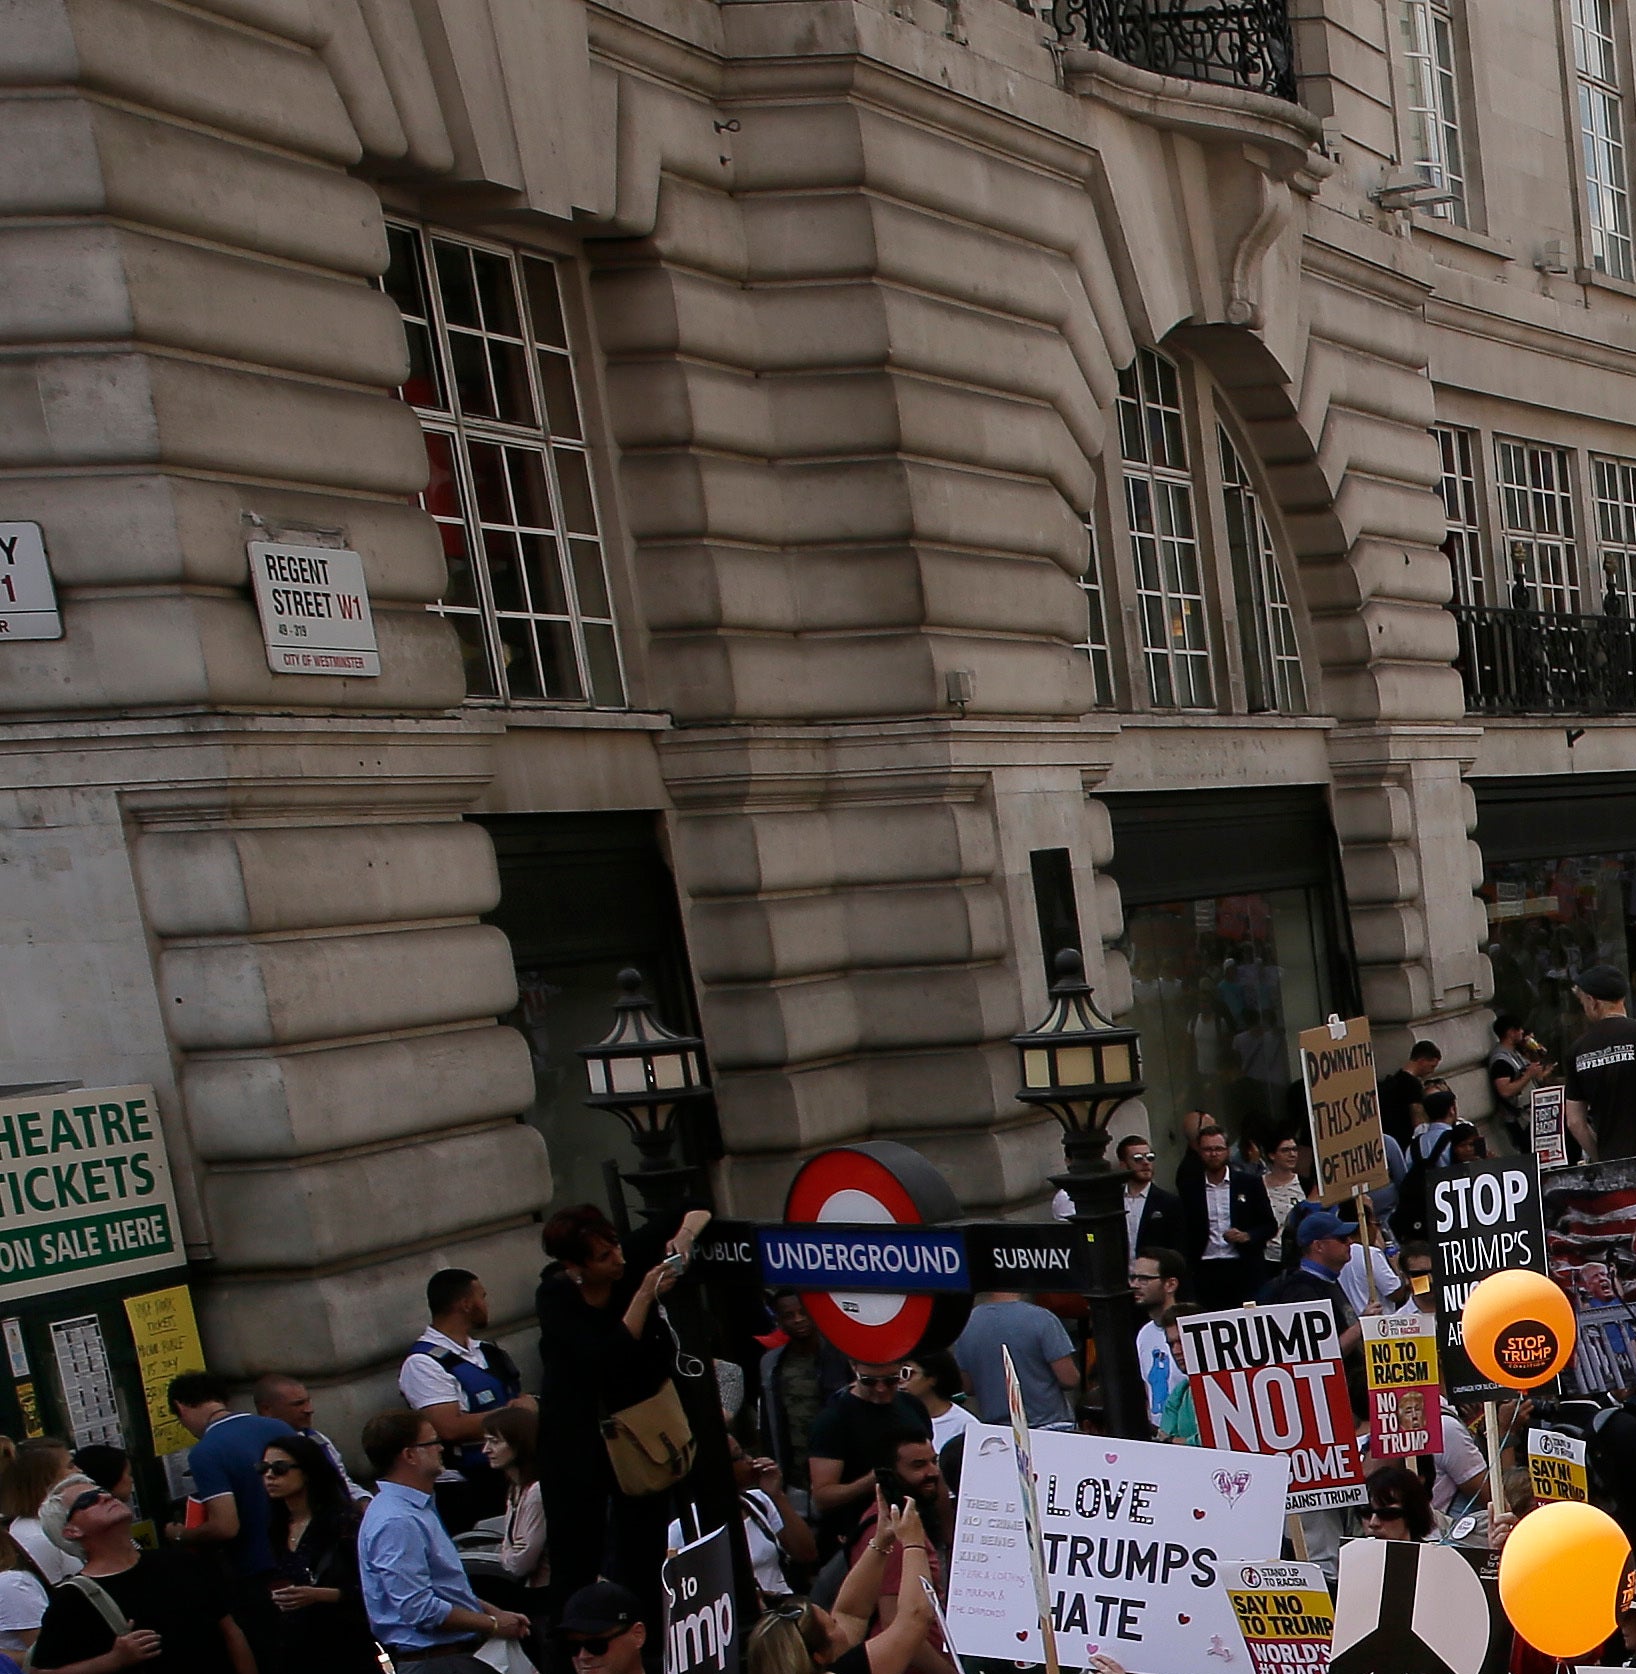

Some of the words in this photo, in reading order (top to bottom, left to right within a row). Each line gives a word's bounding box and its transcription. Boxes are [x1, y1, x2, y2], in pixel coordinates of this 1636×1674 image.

[264, 554, 329, 585] REGENT
[272, 588, 332, 618] STREET
[336, 594, 362, 620] W1
[283, 654, 300, 665] CITY
[302, 655, 312, 666] OF
[312, 655, 364, 668] WESTMINSTER
[0, 1238, 35, 1272] ON
[40, 1227, 101, 1264] SALE
[105, 1215, 165, 1252] HERE
[765, 1242, 961, 1274] UNDERGROUND
[993, 1248, 1071, 1270] SUBWAY
[1184, 1310, 1332, 1373] TRUMP
[1502, 1346, 1552, 1361] TRUMP
[1506, 1334, 1546, 1350] STOP
[1199, 1362, 1341, 1456] NOT
[1047, 1474, 1158, 1524] LOVE
[1042, 1534, 1217, 1587] TRUMPS
